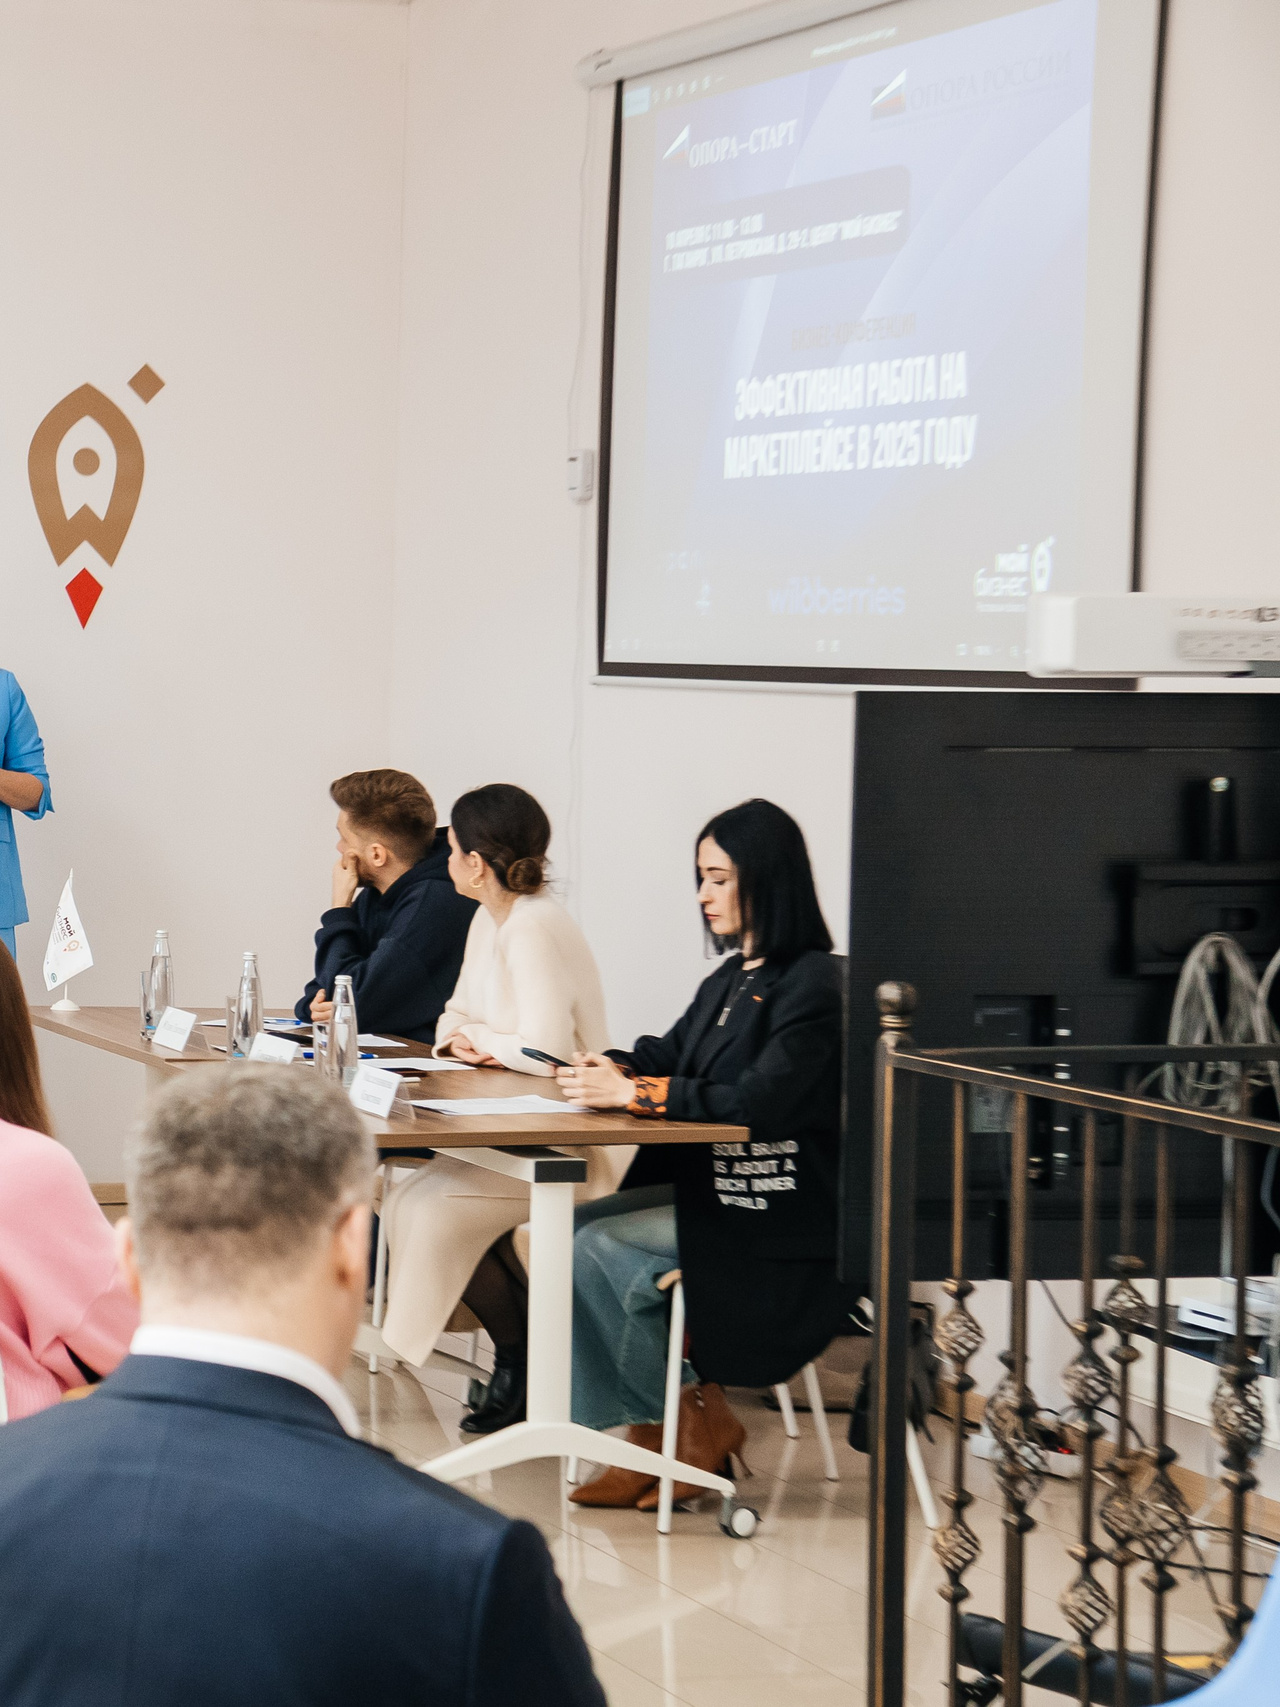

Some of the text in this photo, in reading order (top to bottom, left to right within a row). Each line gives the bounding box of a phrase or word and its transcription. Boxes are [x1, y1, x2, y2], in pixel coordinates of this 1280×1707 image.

[734, 350, 968, 422] ЭФФЕКТИВНАЯ РАБОТА НА
[723, 413, 979, 480] МАРКЕТПЛЕЙСЕ В 2025 ГОДУ
[750, 1140, 800, 1157] BRAND
[713, 1158, 798, 1175] IS ABOUT A
[714, 1176, 797, 1192] RICH INNER
[717, 1193, 768, 1210] WORLD
